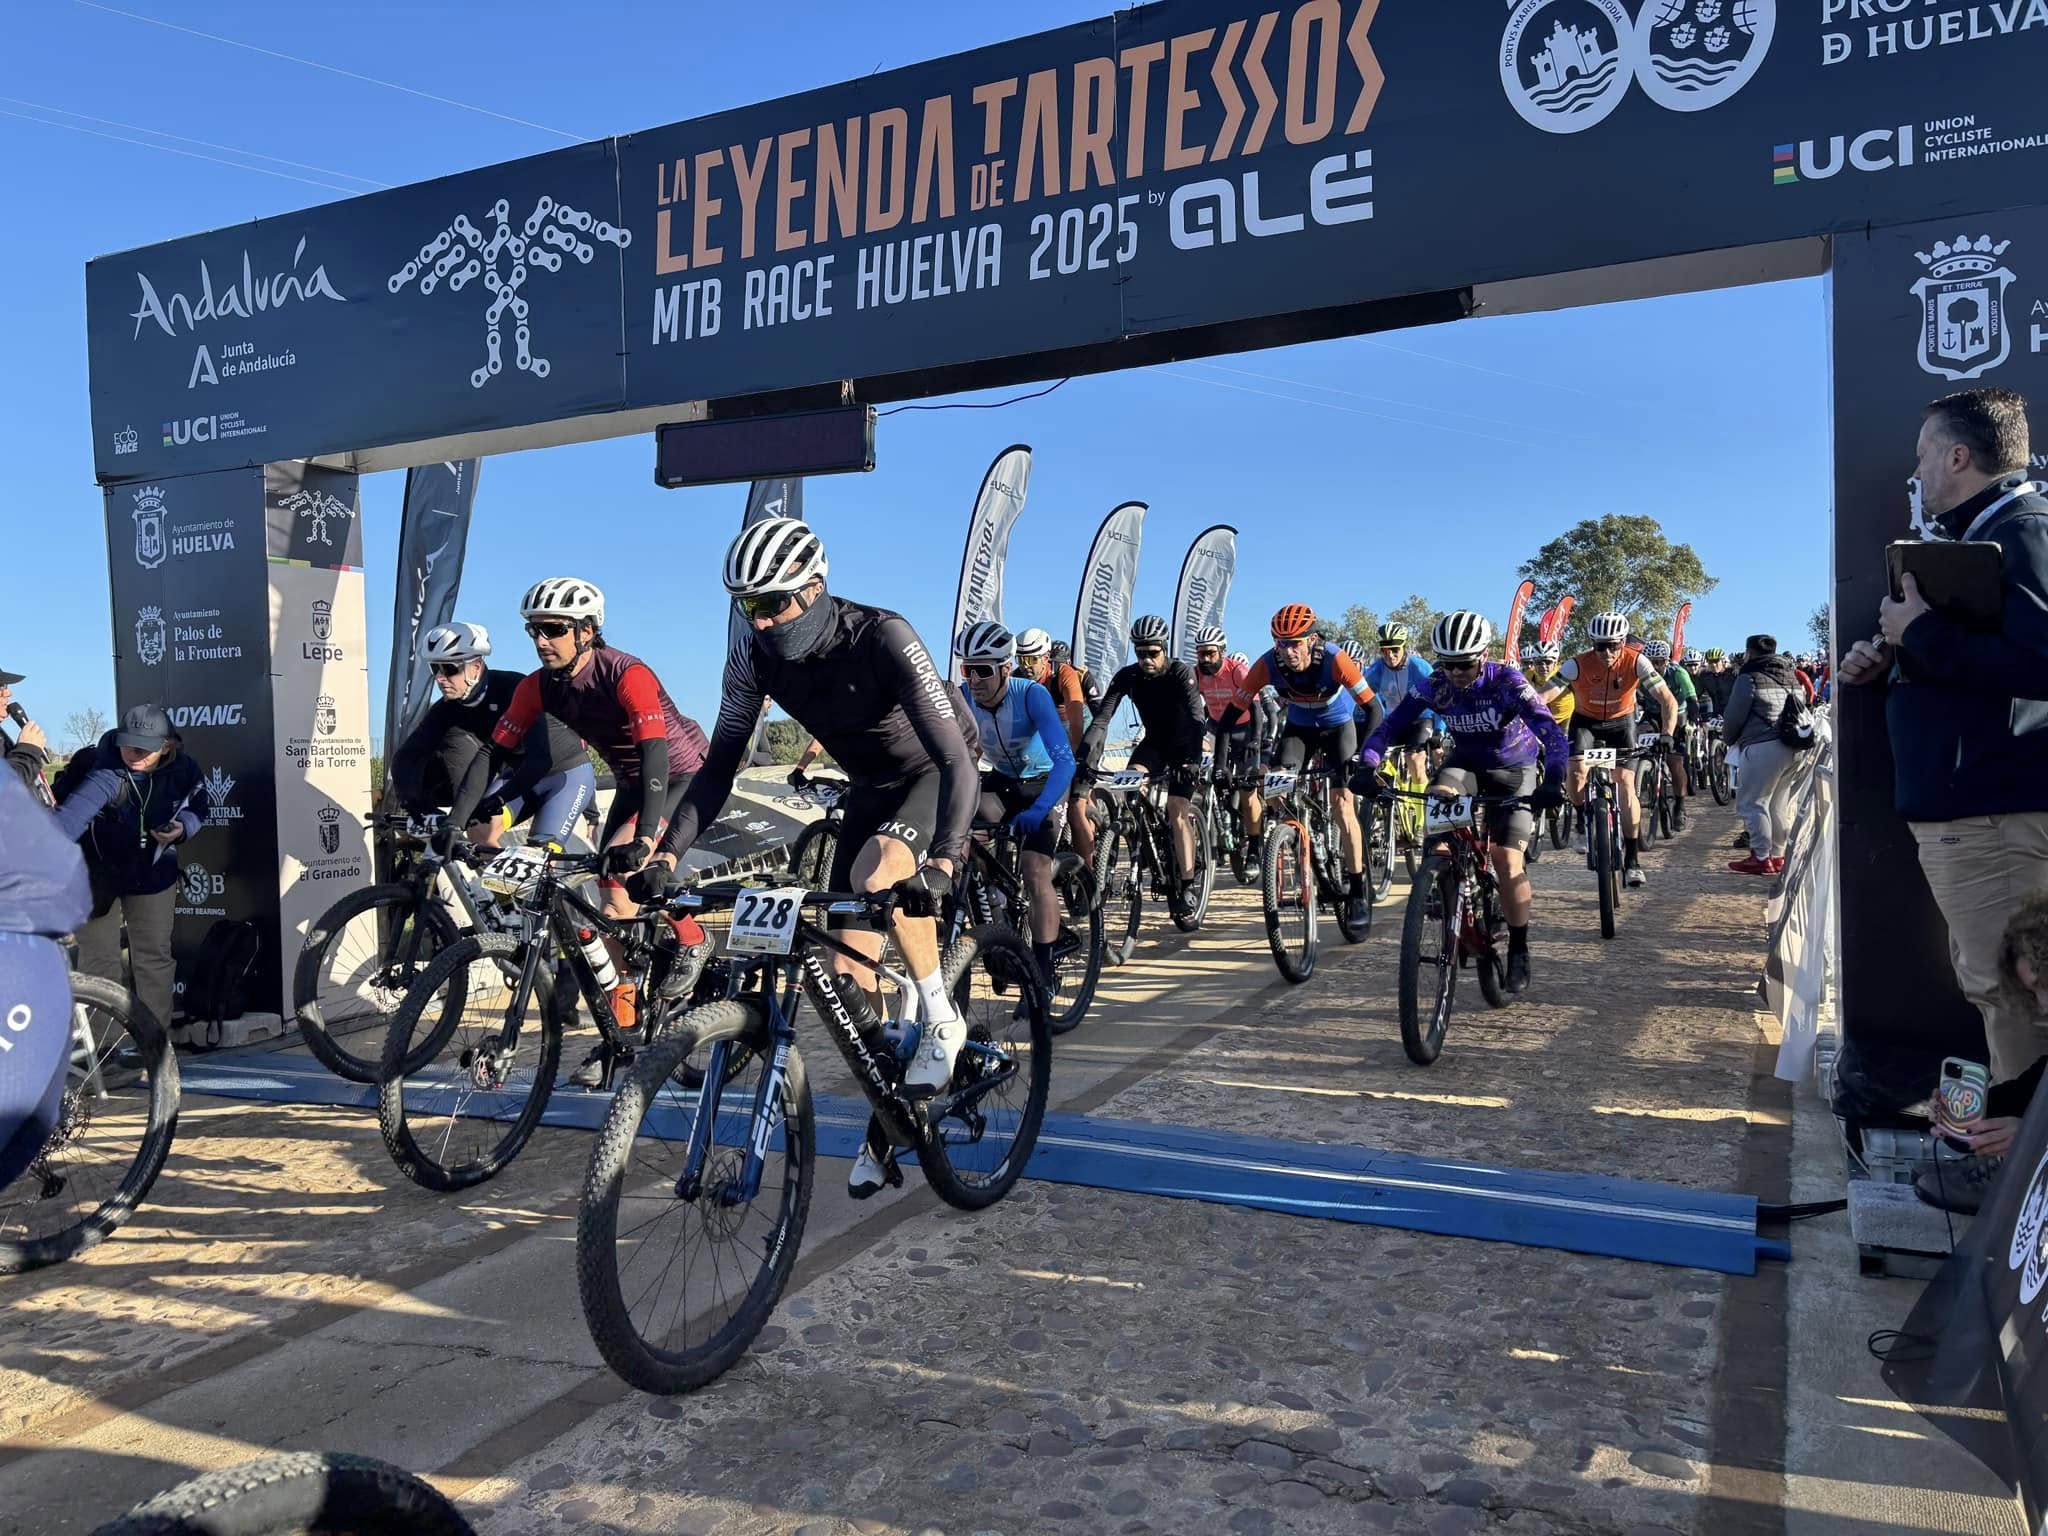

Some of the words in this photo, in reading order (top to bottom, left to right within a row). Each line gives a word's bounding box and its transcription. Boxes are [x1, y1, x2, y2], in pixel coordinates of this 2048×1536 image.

[1513, 0, 1538, 28] MARIS
[972, 0, 1386, 203] TARTESSOS
[1924, 114, 1976, 133] UNION
[1924, 127, 1992, 148] CYCLISTE
[1798, 124, 1914, 181] UCI
[656, 94, 956, 276] LEYENDA
[657, 158, 687, 205] LA
[970, 159, 1005, 211] DE
[1148, 188, 1166, 207] by
[652, 277, 722, 346] MTB
[743, 254, 835, 330] RACE
[856, 222, 1002, 311] HUELVA
[1029, 193, 1140, 281] 2025
[129, 234, 348, 341] Andalucía
[1942, 284, 1953, 292] ET
[1927, 298, 1935, 322] MARIS
[1990, 300, 1999, 337] CUSTODIA
[1927, 324, 1936, 353] PORTUS
[221, 341, 254, 360] Junta
[221, 362, 237, 378] de
[238, 349, 297, 375] Andalucía
[219, 411, 240, 422] UNION
[219, 419, 246, 431] CYCLISTE
[113, 428, 138, 445] ECO
[172, 415, 218, 446] UCI
[220, 425, 268, 440] INTERNATIONALE
[114, 441, 138, 455] RACE
[171, 520, 223, 536] Ayuntamiento
[224, 517, 235, 528] de
[1108, 530, 1123, 542] UCI
[172, 532, 236, 556] HUELVA
[1199, 548, 1215, 559] UCI
[967, 518, 995, 607] TARTESSOS
[1087, 560, 1114, 636] TARTESSOS
[1184, 574, 1208, 639] TARTESSOS
[172, 608, 221, 622] Ayuntamiento
[174, 624, 205, 642] Palos
[207, 623, 223, 640] de
[175, 646, 186, 662] la
[188, 644, 242, 661] Frontera
[302, 641, 344, 665] Lepe
[166, 703, 243, 728] AOYANG
[285, 744, 308, 757] San
[310, 744, 367, 757] Bartolomé
[296, 757, 311, 768] de
[314, 756, 324, 768] la
[326, 756, 357, 768] Torre
[208, 806, 245, 819] RURAL
[215, 818, 230, 827] SUR
[300, 869, 309, 881] El
[312, 865, 361, 880] Granado
[175, 907, 194, 915] SPORT
[736, 895, 794, 930] 228
